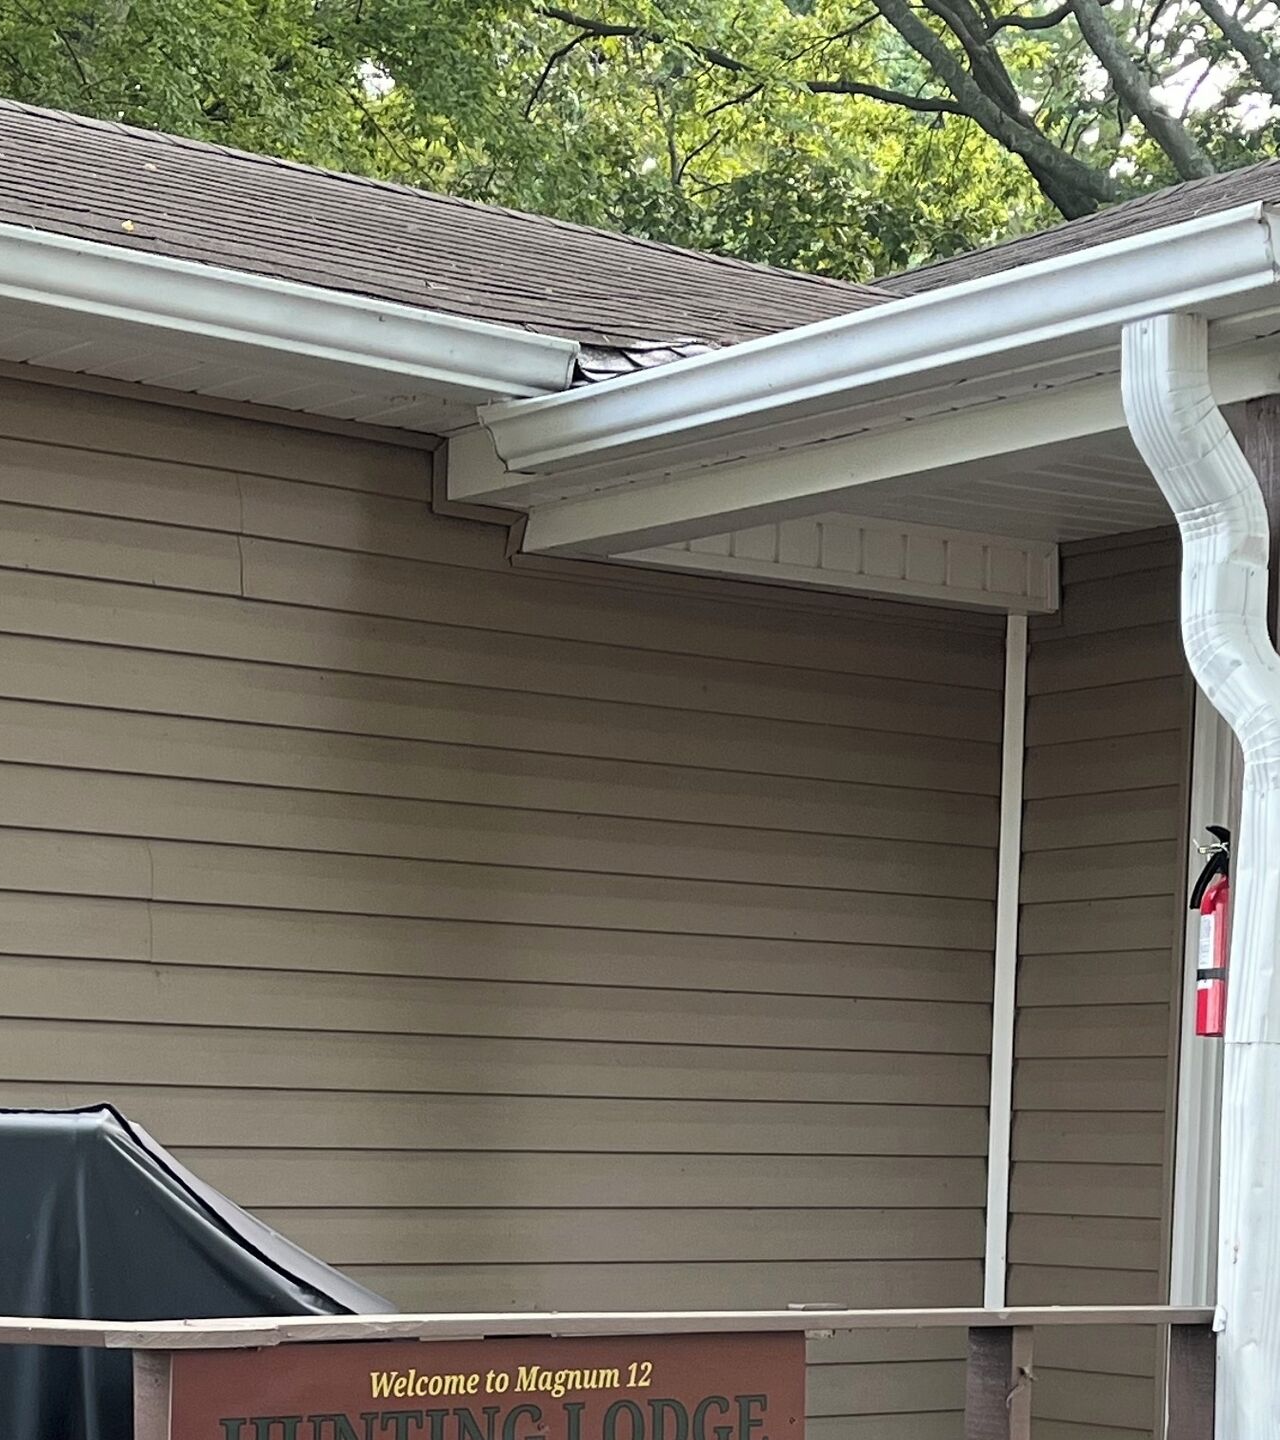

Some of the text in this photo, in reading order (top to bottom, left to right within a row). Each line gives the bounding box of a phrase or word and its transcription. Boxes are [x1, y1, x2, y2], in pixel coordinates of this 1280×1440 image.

[369, 1361, 653, 1398] Welcome to Magnum 12
